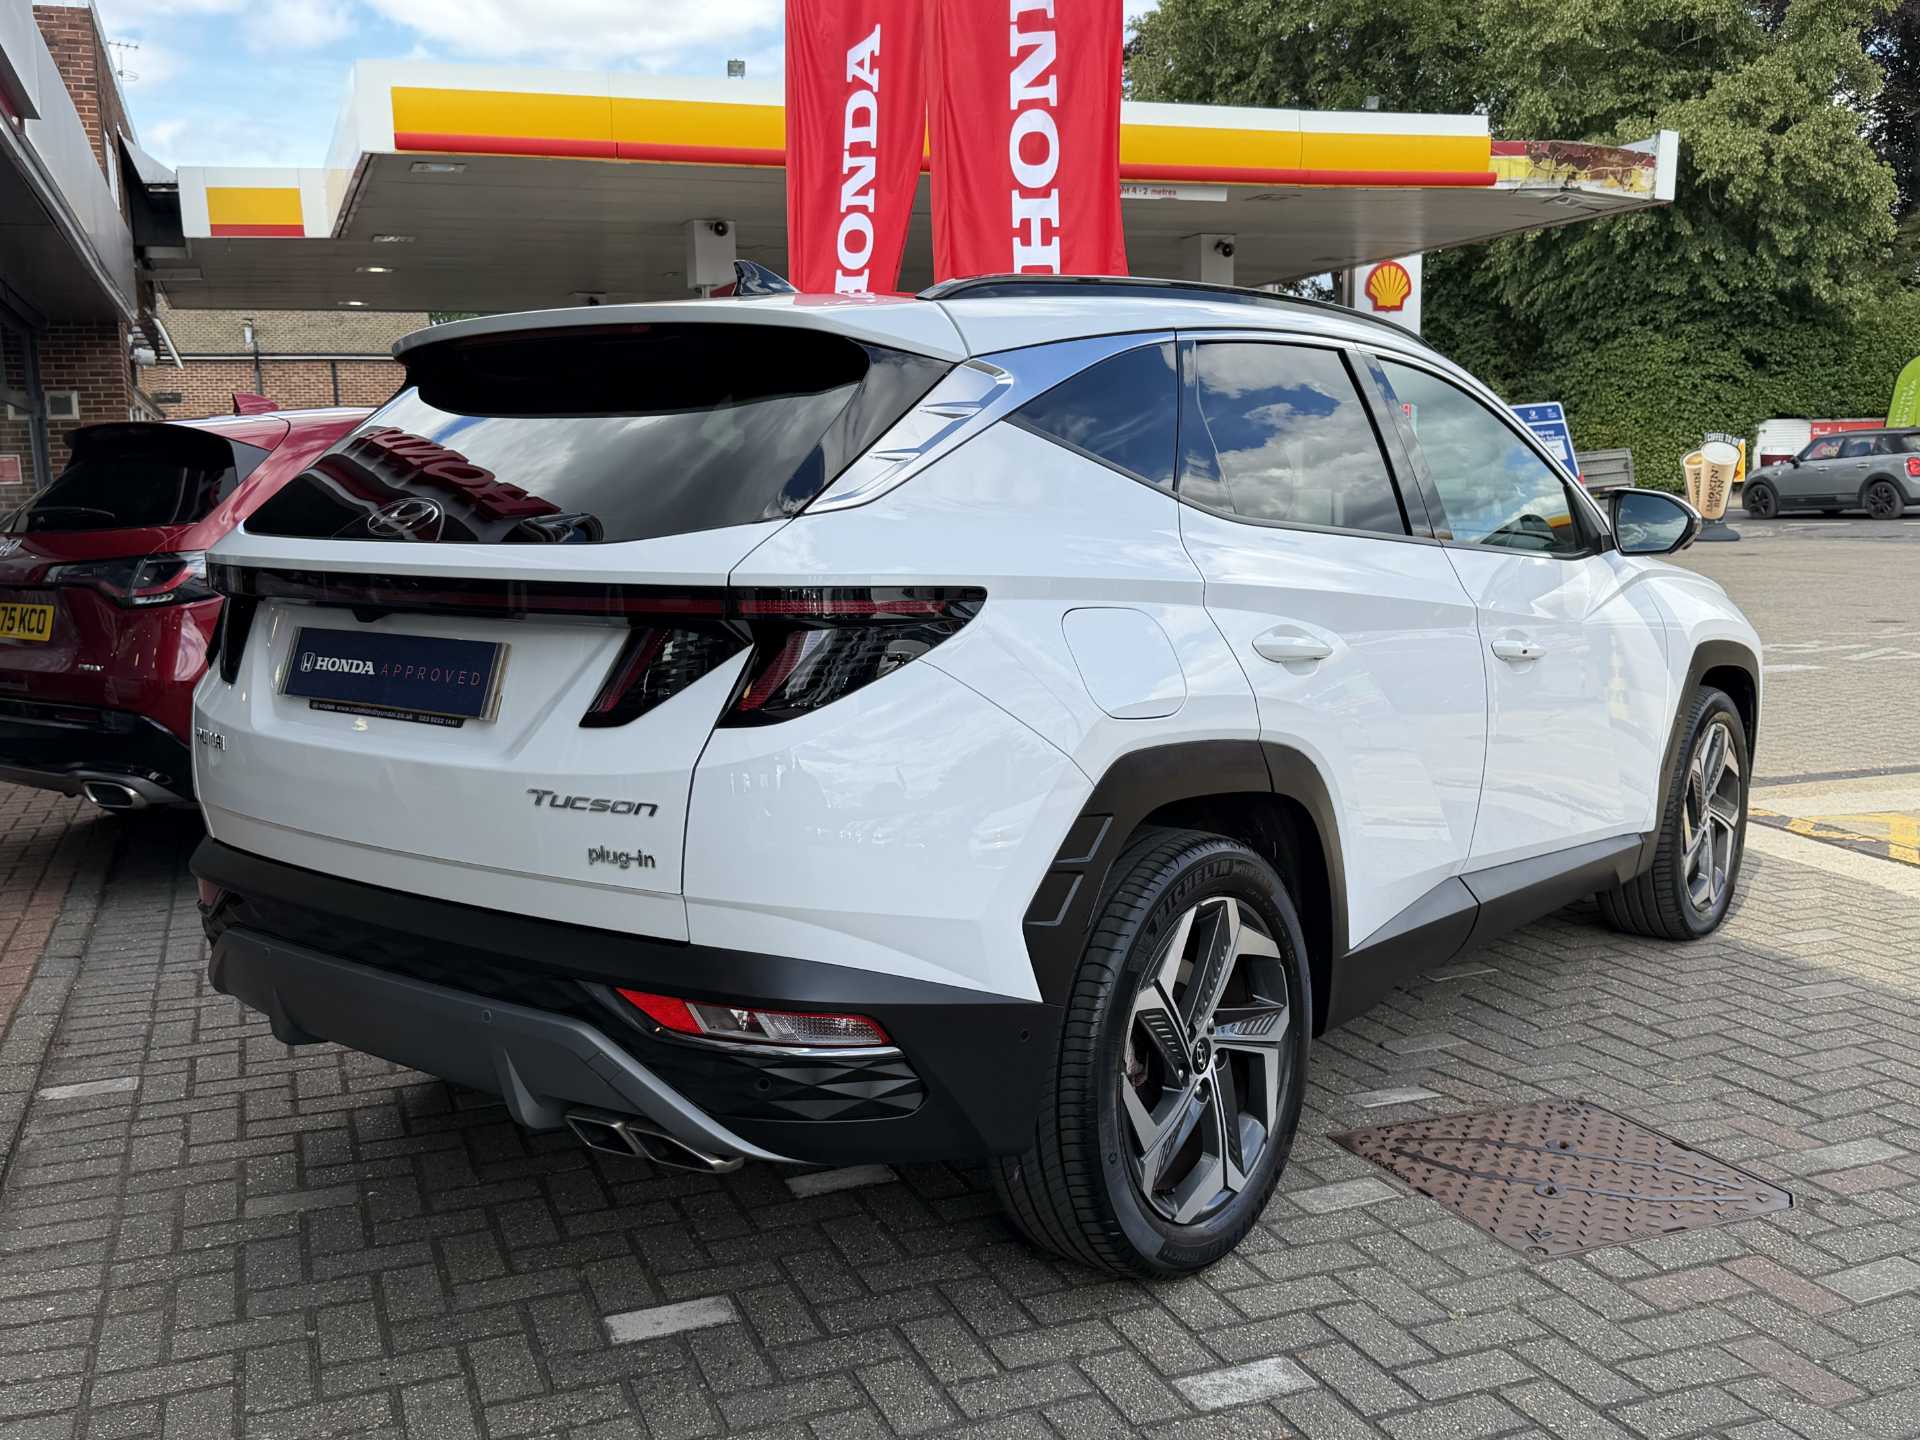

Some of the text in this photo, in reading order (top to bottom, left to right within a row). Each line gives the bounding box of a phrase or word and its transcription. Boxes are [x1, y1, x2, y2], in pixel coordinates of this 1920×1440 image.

[1009, 0, 1061, 274] HON
[18, 608, 47, 634] KCO
[315, 656, 481, 686] HONDA APPROVED
[588, 844, 657, 870] plug-in
